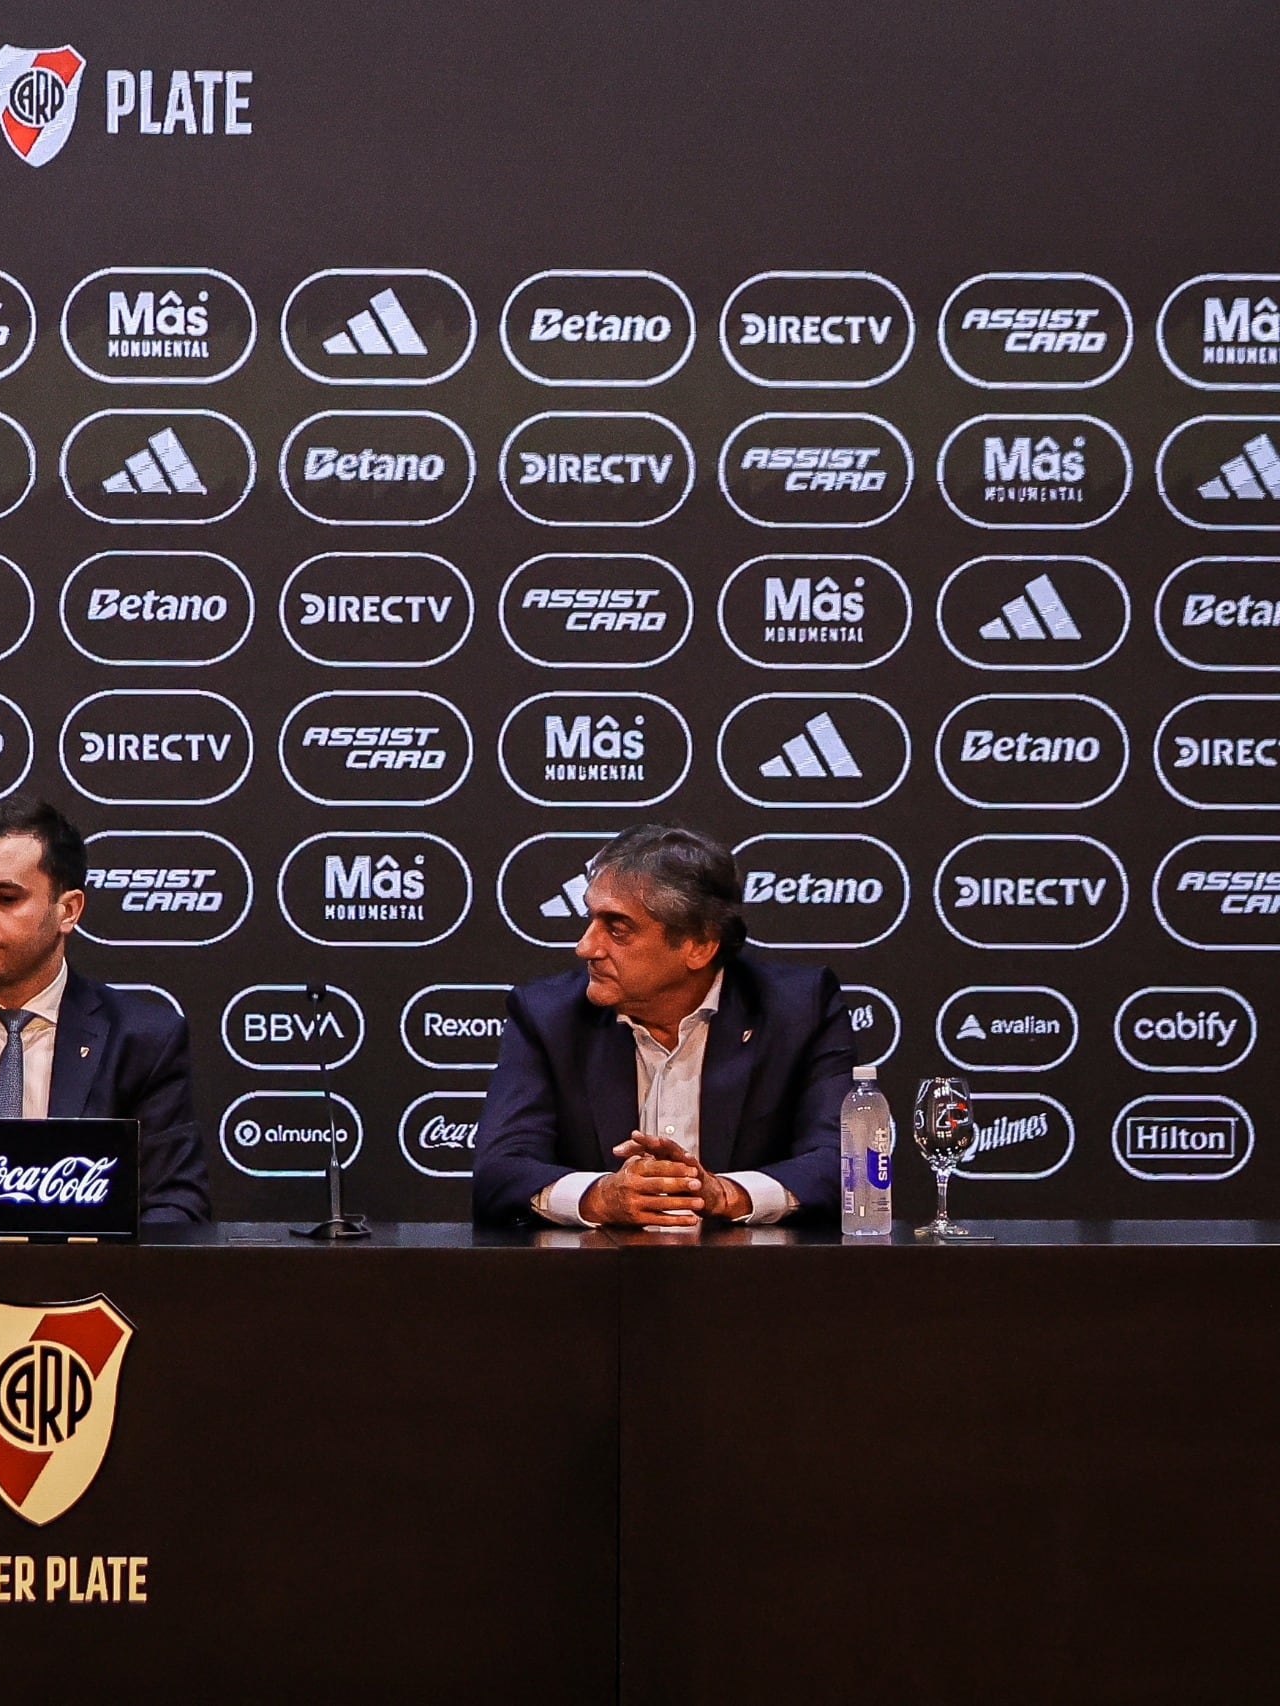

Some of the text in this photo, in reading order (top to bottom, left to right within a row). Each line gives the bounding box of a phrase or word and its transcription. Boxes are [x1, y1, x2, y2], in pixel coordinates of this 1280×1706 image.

[106, 69, 254, 135] PLATE
[529, 308, 672, 343] Betano
[739, 312, 892, 346] DIRECTV
[961, 308, 1100, 331] ASSIST
[1203, 296, 1280, 343] Mâ
[107, 339, 210, 359] MONUMENTAL
[1004, 330, 1108, 353] CARD
[303, 447, 445, 482] Betano
[519, 452, 673, 485] DIRECTV
[740, 447, 881, 470] ASSIST
[784, 470, 888, 492] CARD
[87, 588, 227, 622] Betano
[300, 592, 453, 625] DIRECTV
[521, 588, 660, 609] ASSIST
[1182, 594, 1280, 627] Beta
[565, 611, 667, 631] CARD
[764, 626, 864, 643] MONUMENTAL
[79, 731, 232, 763] DIRECTV
[302, 726, 440, 747] ASSIST
[960, 729, 1100, 762] Betano
[1173, 736, 1280, 768] DIREC
[345, 749, 447, 770] CARD
[544, 764, 645, 781] MONUMENTAL
[743, 871, 883, 904] Betano
[954, 876, 1107, 908] DIRECTV
[1176, 871, 1280, 891] ASSIS
[121, 891, 223, 912] CARD
[324, 904, 424, 921] MONUMENTAL
[244, 1011, 345, 1042] BBVA
[990, 1015, 1061, 1035] avalian
[1133, 1010, 1238, 1047] cabify
[1134, 1125, 1226, 1151] Hilton
[875, 1127, 889, 1182] smart
[46, 1555, 149, 1603] PLATE
